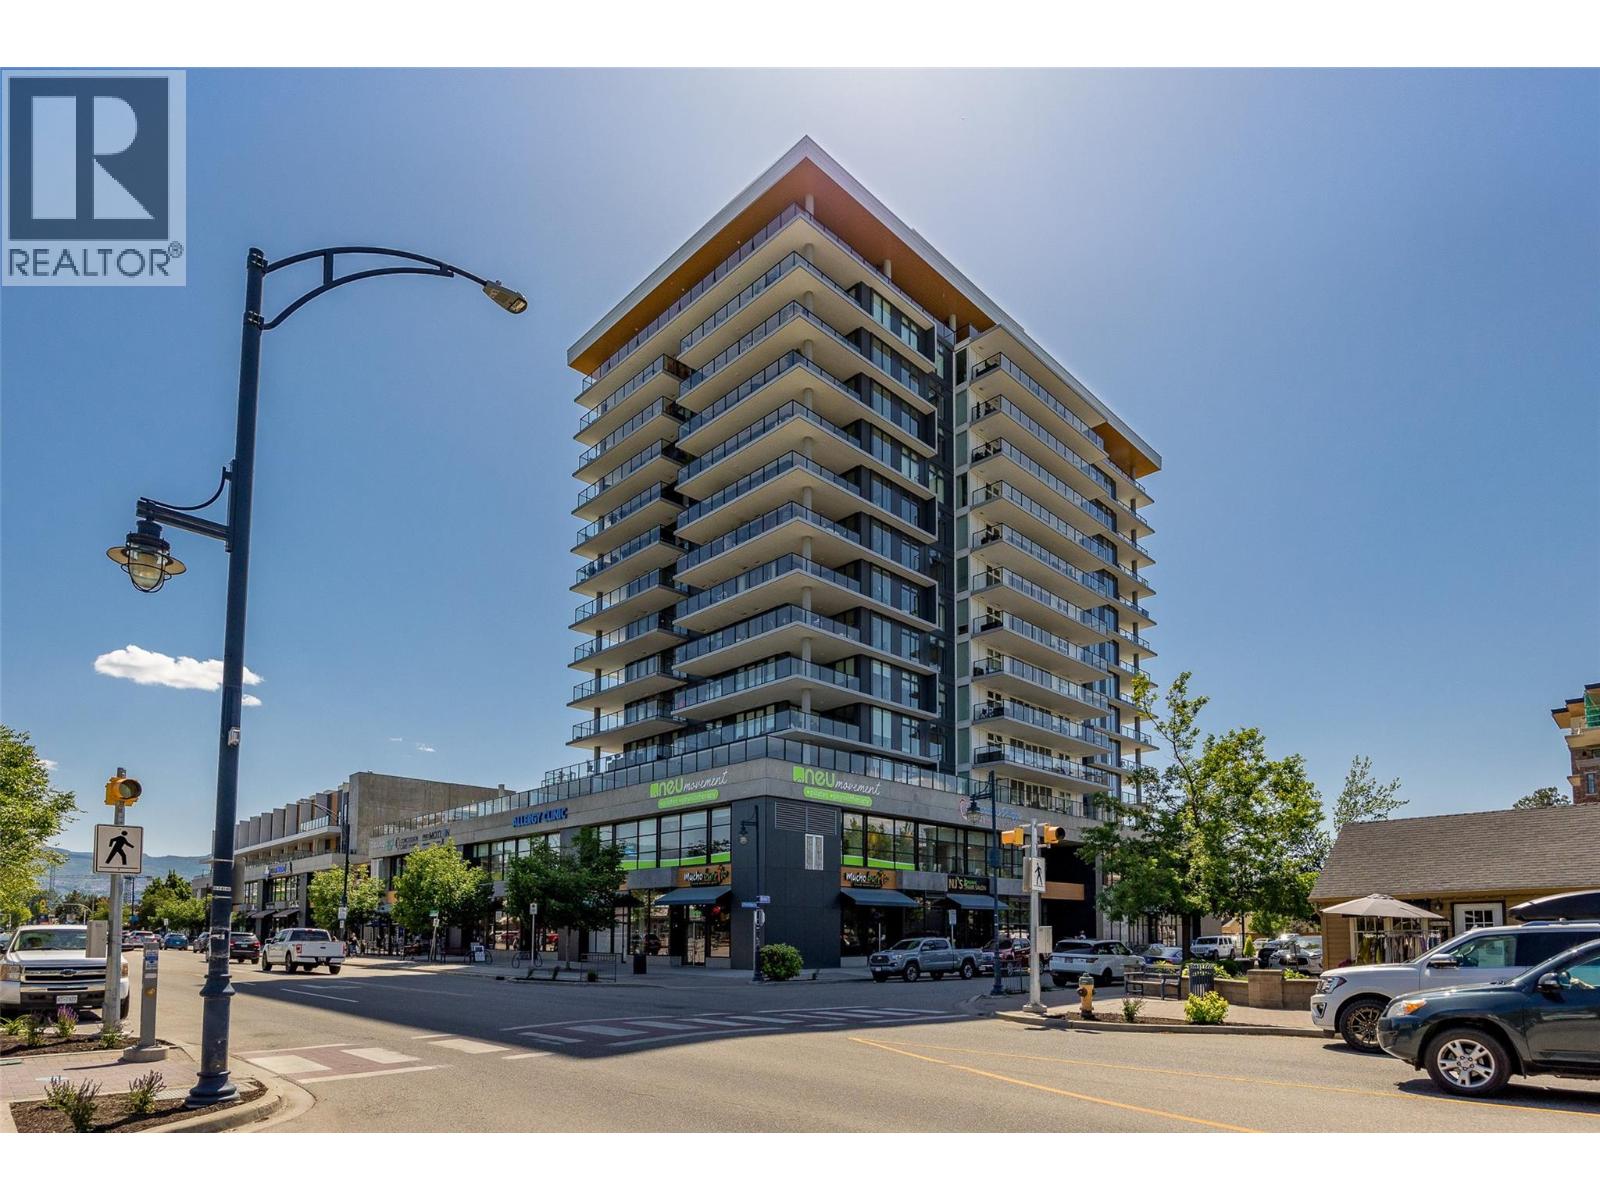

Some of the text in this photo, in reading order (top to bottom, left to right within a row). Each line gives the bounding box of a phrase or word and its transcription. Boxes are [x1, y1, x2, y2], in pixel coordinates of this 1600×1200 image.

[683, 769, 728, 792] movement
[834, 781, 881, 796] movement
[512, 807, 568, 827] ALLERGY CLINIC
